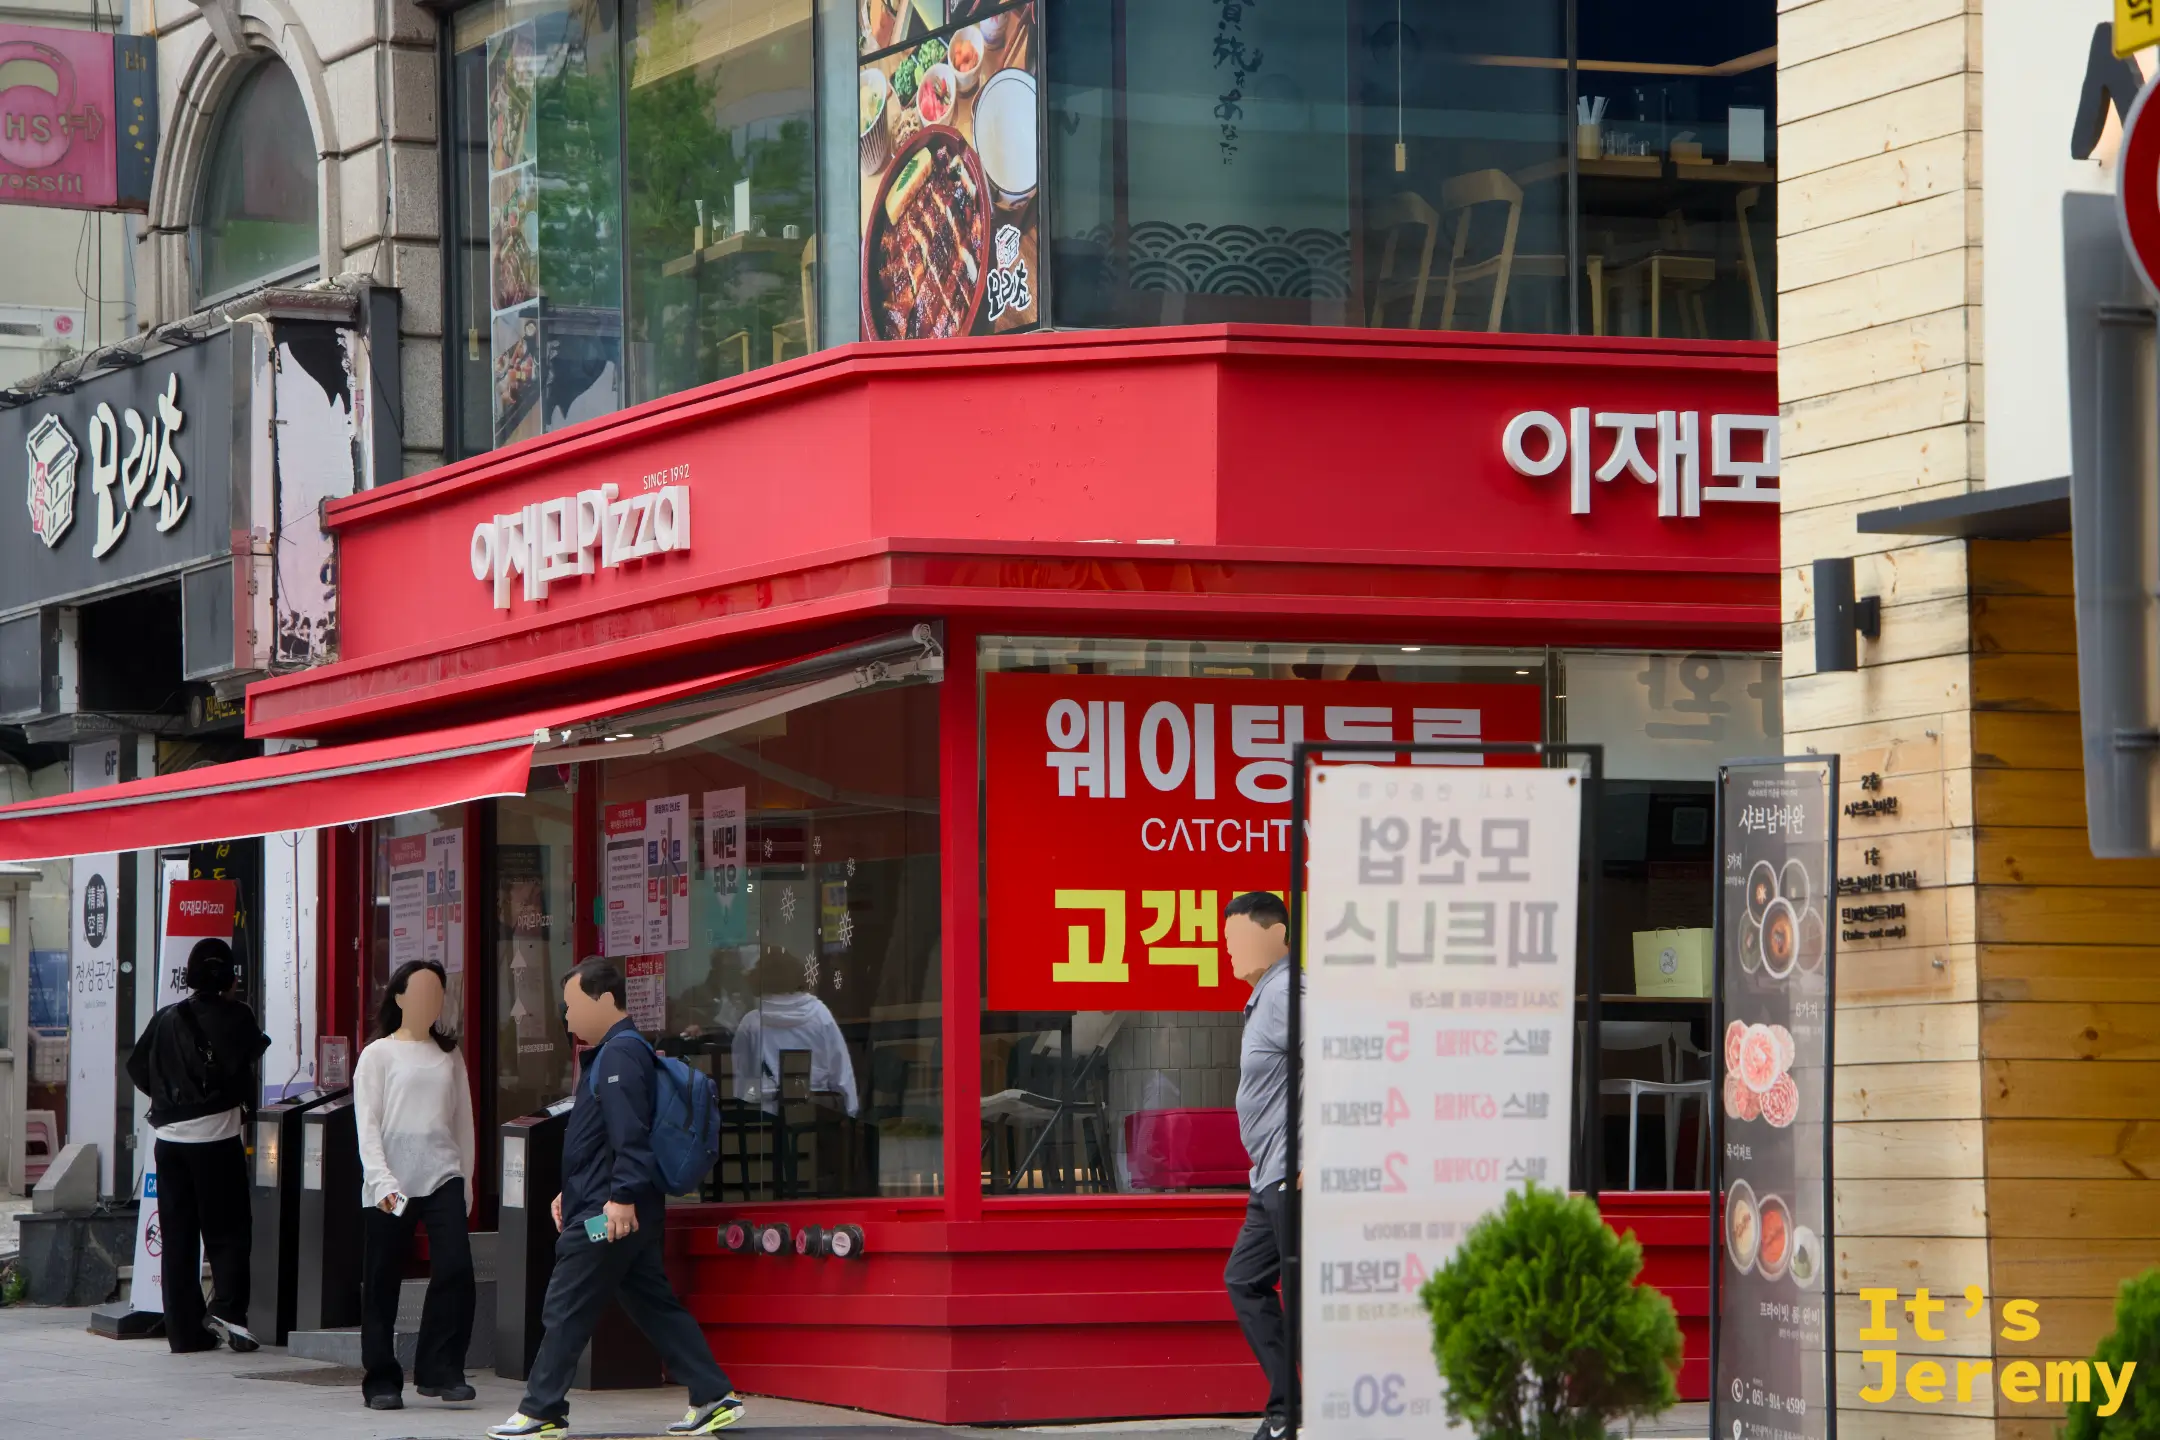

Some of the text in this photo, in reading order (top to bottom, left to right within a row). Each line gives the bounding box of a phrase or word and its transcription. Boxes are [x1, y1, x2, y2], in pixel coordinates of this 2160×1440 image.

[5, 113, 51, 142] HS
[643, 463, 690, 490] SINCE 1992
[104, 751, 117, 776] 6F
[1738, 803, 1805, 835] 샤브남바완
[76, 957, 116, 994] 정성공간
